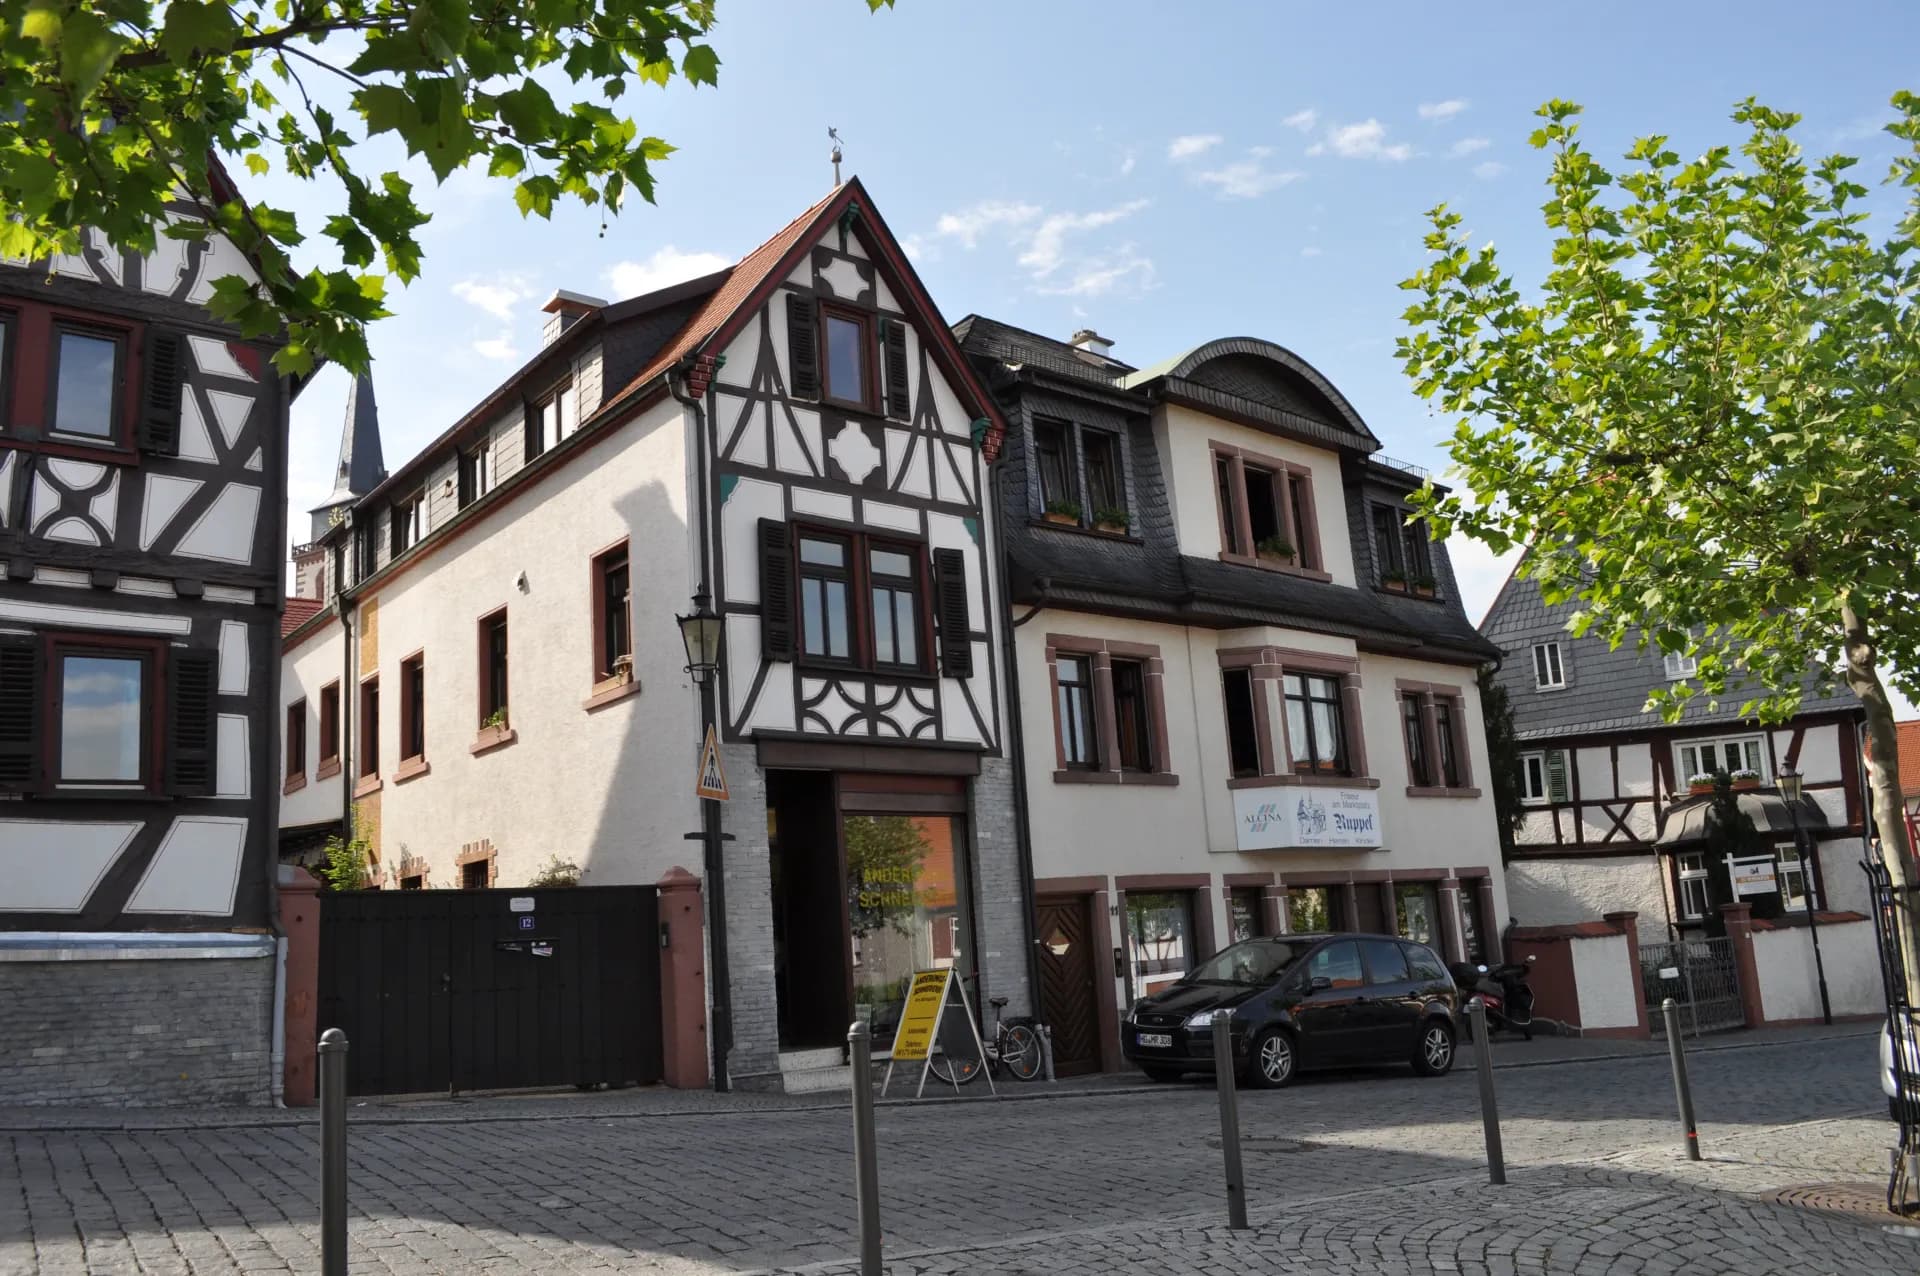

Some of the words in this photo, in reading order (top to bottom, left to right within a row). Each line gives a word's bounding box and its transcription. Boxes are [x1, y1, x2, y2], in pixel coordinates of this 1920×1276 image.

[1244, 813, 1283, 824] ALCINA
[1333, 813, 1373, 833] Ruppel
[522, 918, 532, 928] 12
